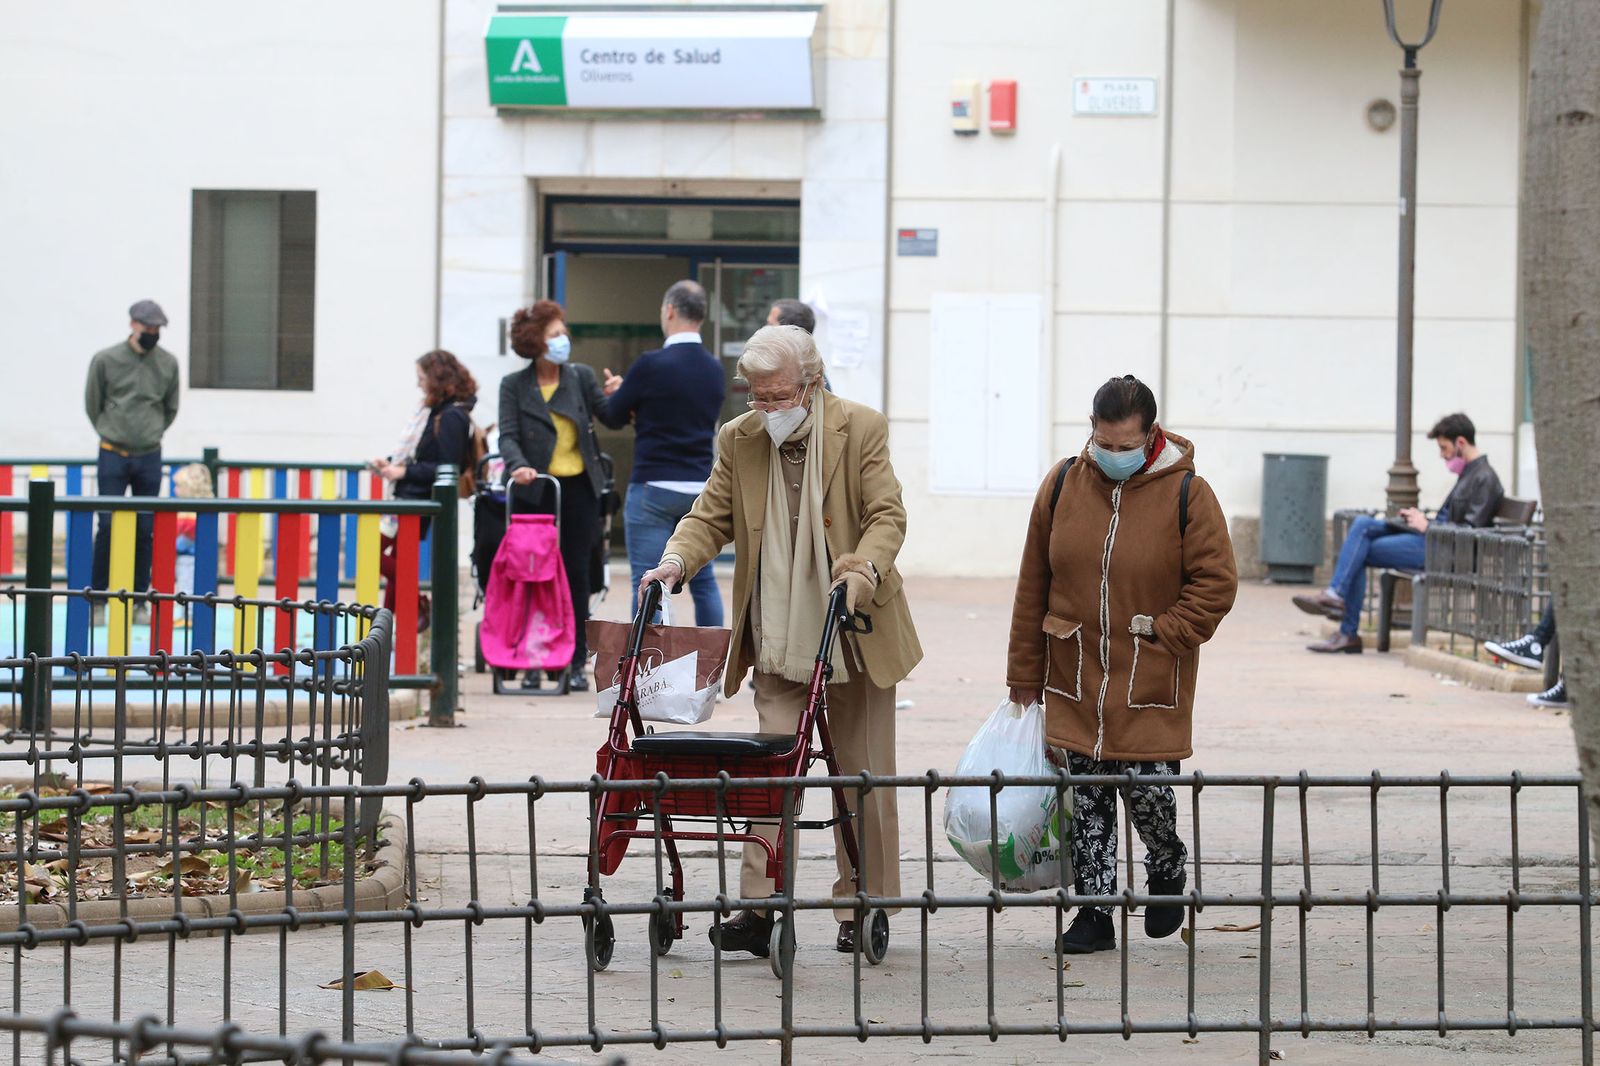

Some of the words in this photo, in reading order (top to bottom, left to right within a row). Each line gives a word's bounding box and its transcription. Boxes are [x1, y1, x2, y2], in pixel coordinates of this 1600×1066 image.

[580, 48, 637, 64] Centro
[644, 47, 665, 64] de
[673, 47, 722, 64] Salud
[580, 69, 634, 82] Oliveros
[1104, 82, 1139, 92] PLAZA
[1087, 95, 1142, 112] OLIVEROS
